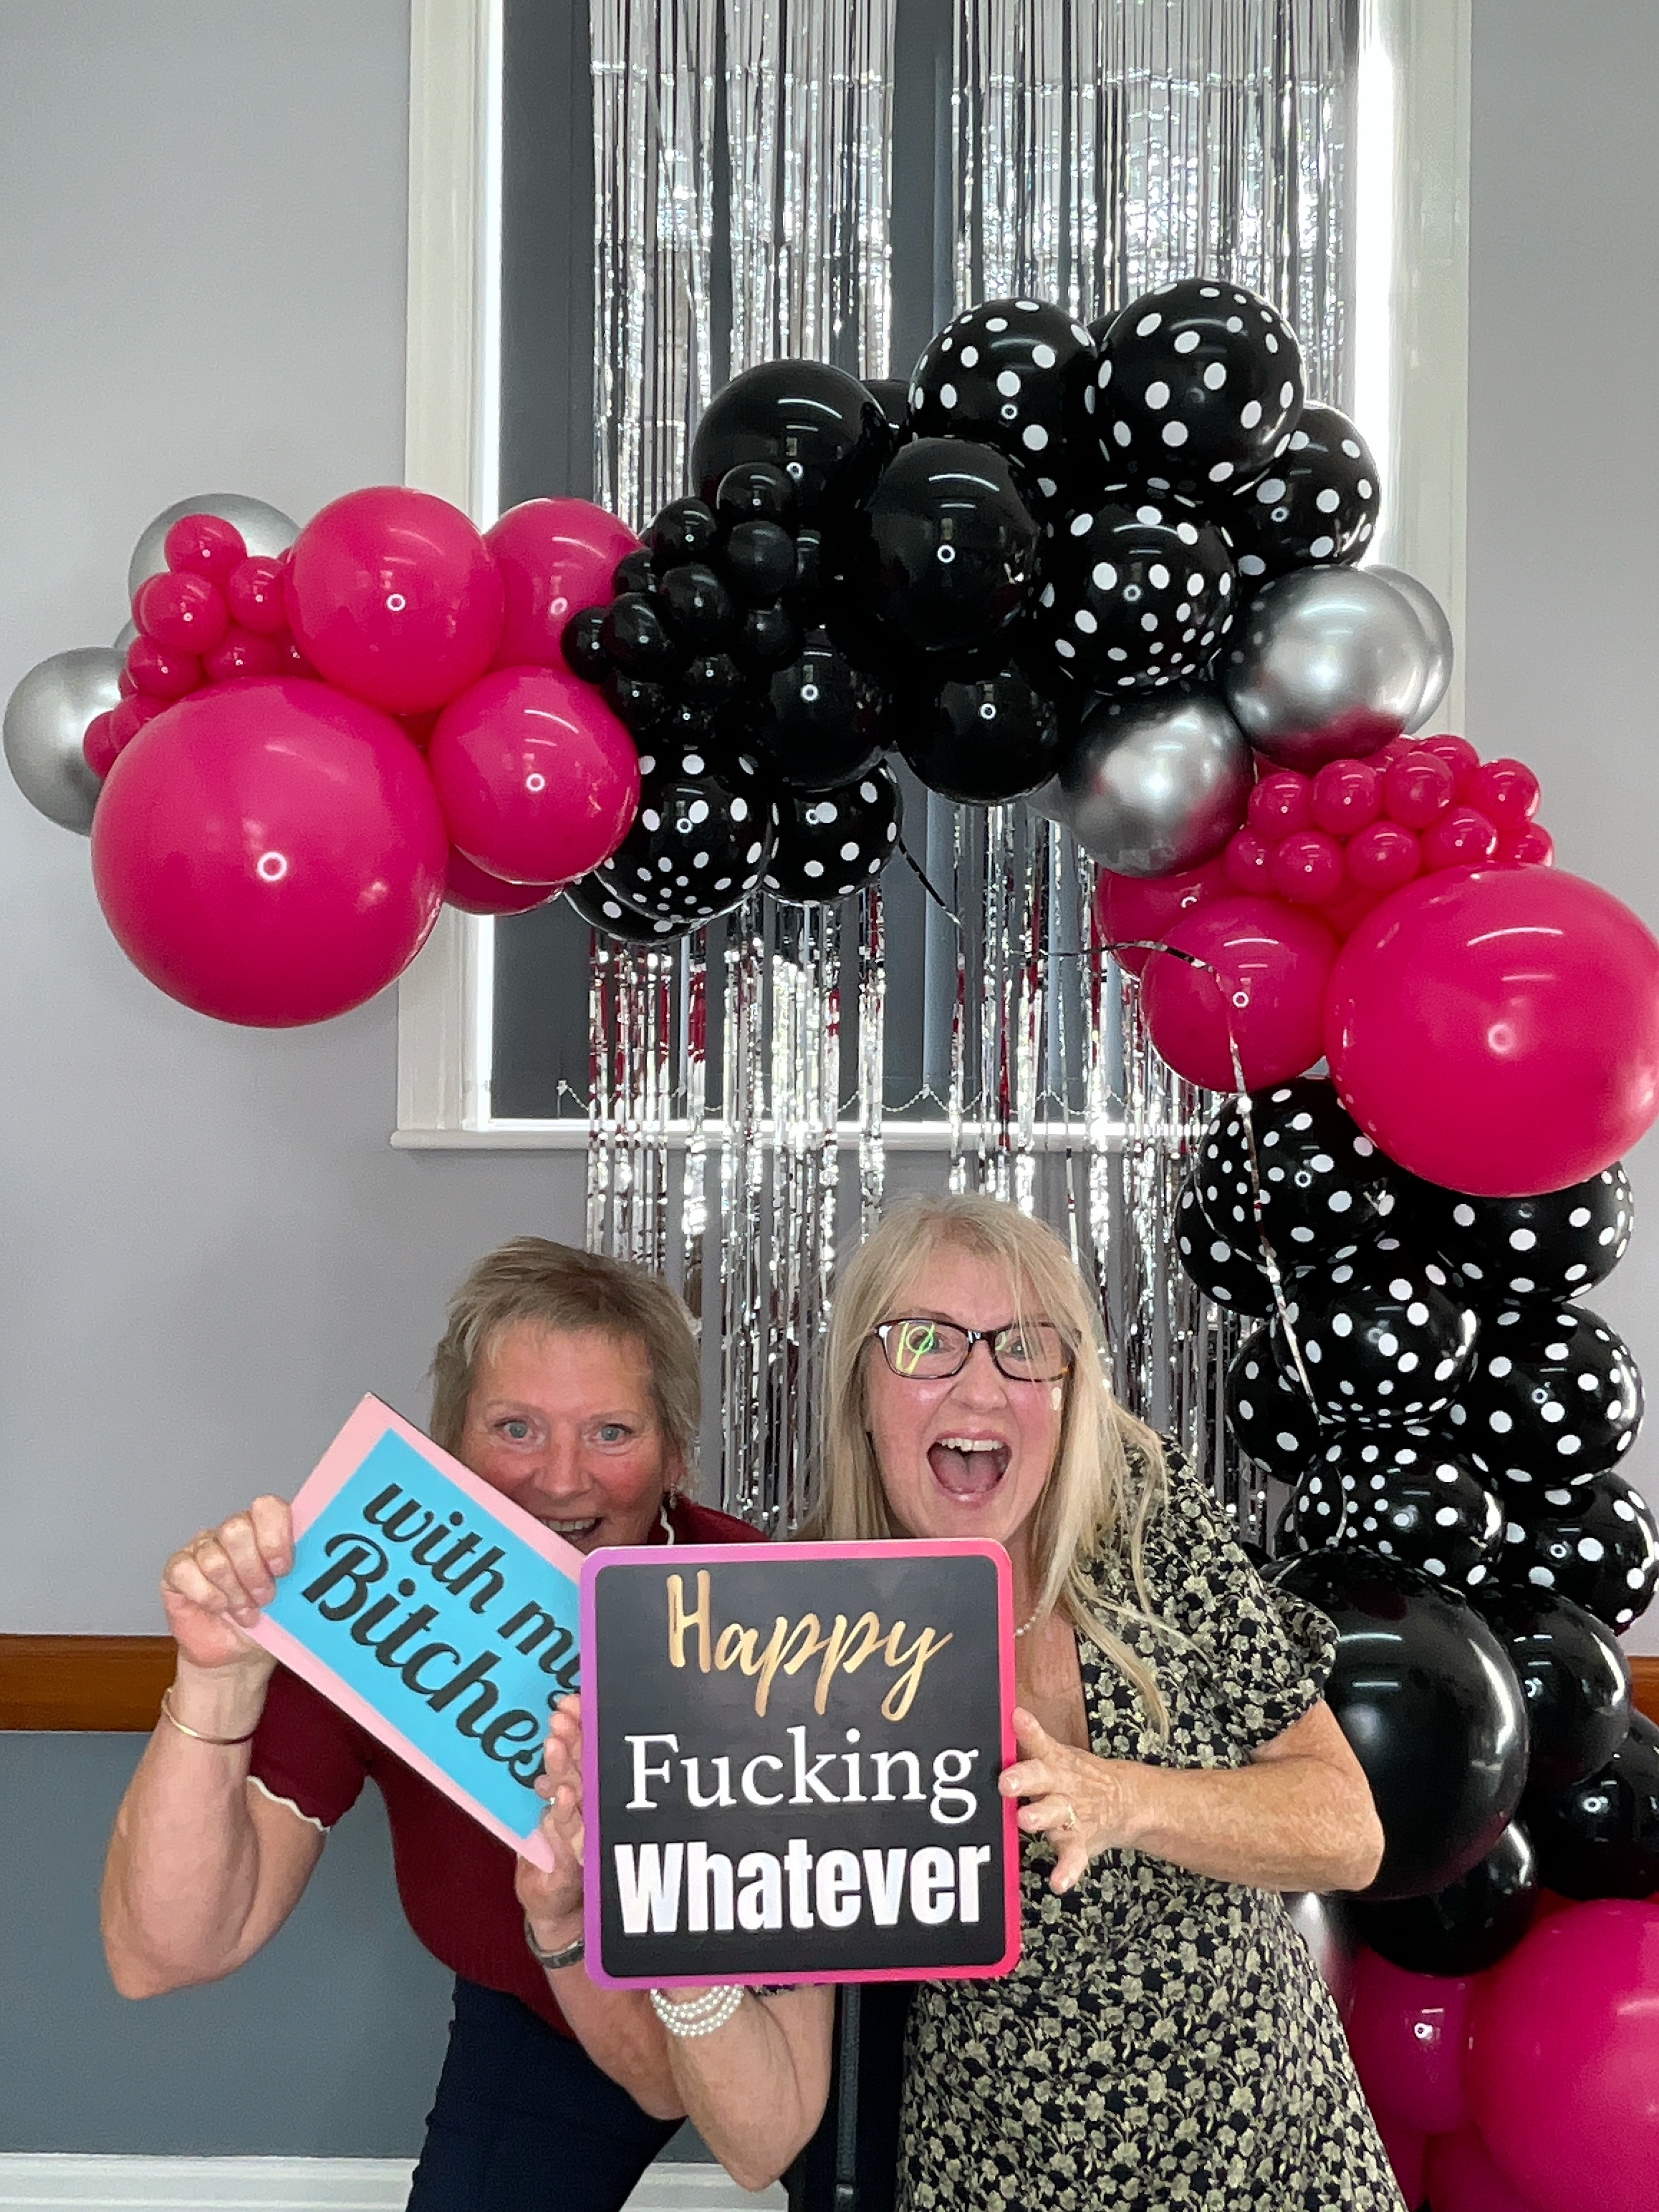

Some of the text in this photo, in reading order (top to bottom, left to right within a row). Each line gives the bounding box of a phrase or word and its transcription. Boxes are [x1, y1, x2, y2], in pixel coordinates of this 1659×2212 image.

[362, 1483, 506, 1615] with
[301, 1533, 546, 1789] Bitches
[666, 1569, 953, 1722] Happy
[624, 1725, 979, 1824] Fucking
[613, 1839, 991, 1934] Whatever
